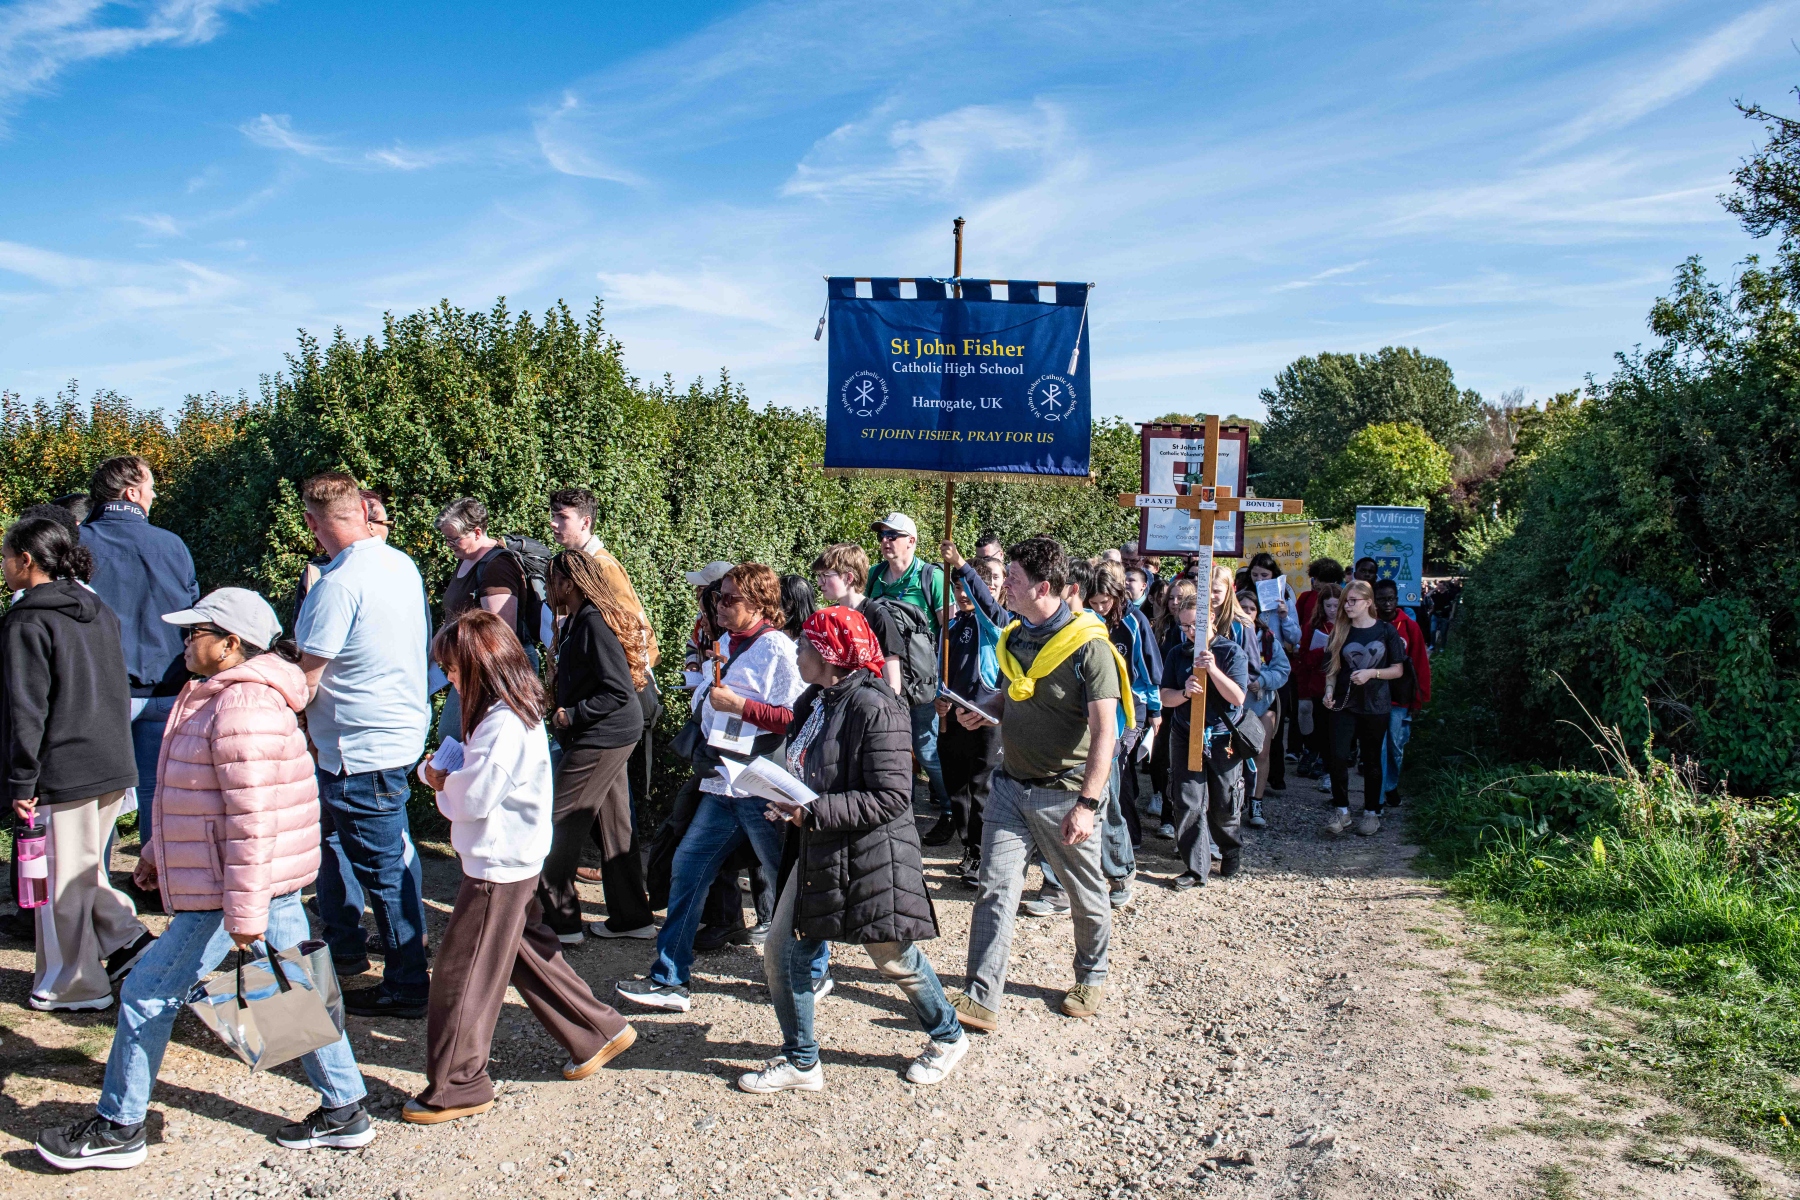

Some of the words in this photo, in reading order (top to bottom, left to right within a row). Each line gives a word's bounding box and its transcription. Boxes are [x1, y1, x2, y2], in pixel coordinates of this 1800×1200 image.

[891, 338, 910, 355] St
[915, 338, 957, 359] John
[962, 339, 1025, 357] Fisher
[854, 370, 880, 380] Catholic
[892, 361, 942, 373] Catholic
[944, 362, 975, 377] High
[979, 362, 1024, 374] School
[841, 375, 855, 391] Fisher
[878, 378, 889, 394] High
[1027, 378, 1041, 395] Fisher
[1041, 374, 1066, 384] Catholic
[1065, 383, 1076, 398] High
[841, 393, 851, 408] John
[875, 395, 889, 414] School
[912, 396, 976, 412] Harrogate,
[979, 397, 1003, 409] UK
[1027, 396, 1038, 411] John
[1063, 400, 1077, 419] School
[861, 428, 877, 438] ST
[879, 429, 916, 441] JOHN
[917, 430, 963, 442] FISHER,
[967, 431, 1003, 441] PRAY
[1005, 431, 1033, 442] FOR
[1037, 432, 1054, 443] US
[1376, 513, 1420, 524] Wilfrid's
[1276, 550, 1303, 558] College
